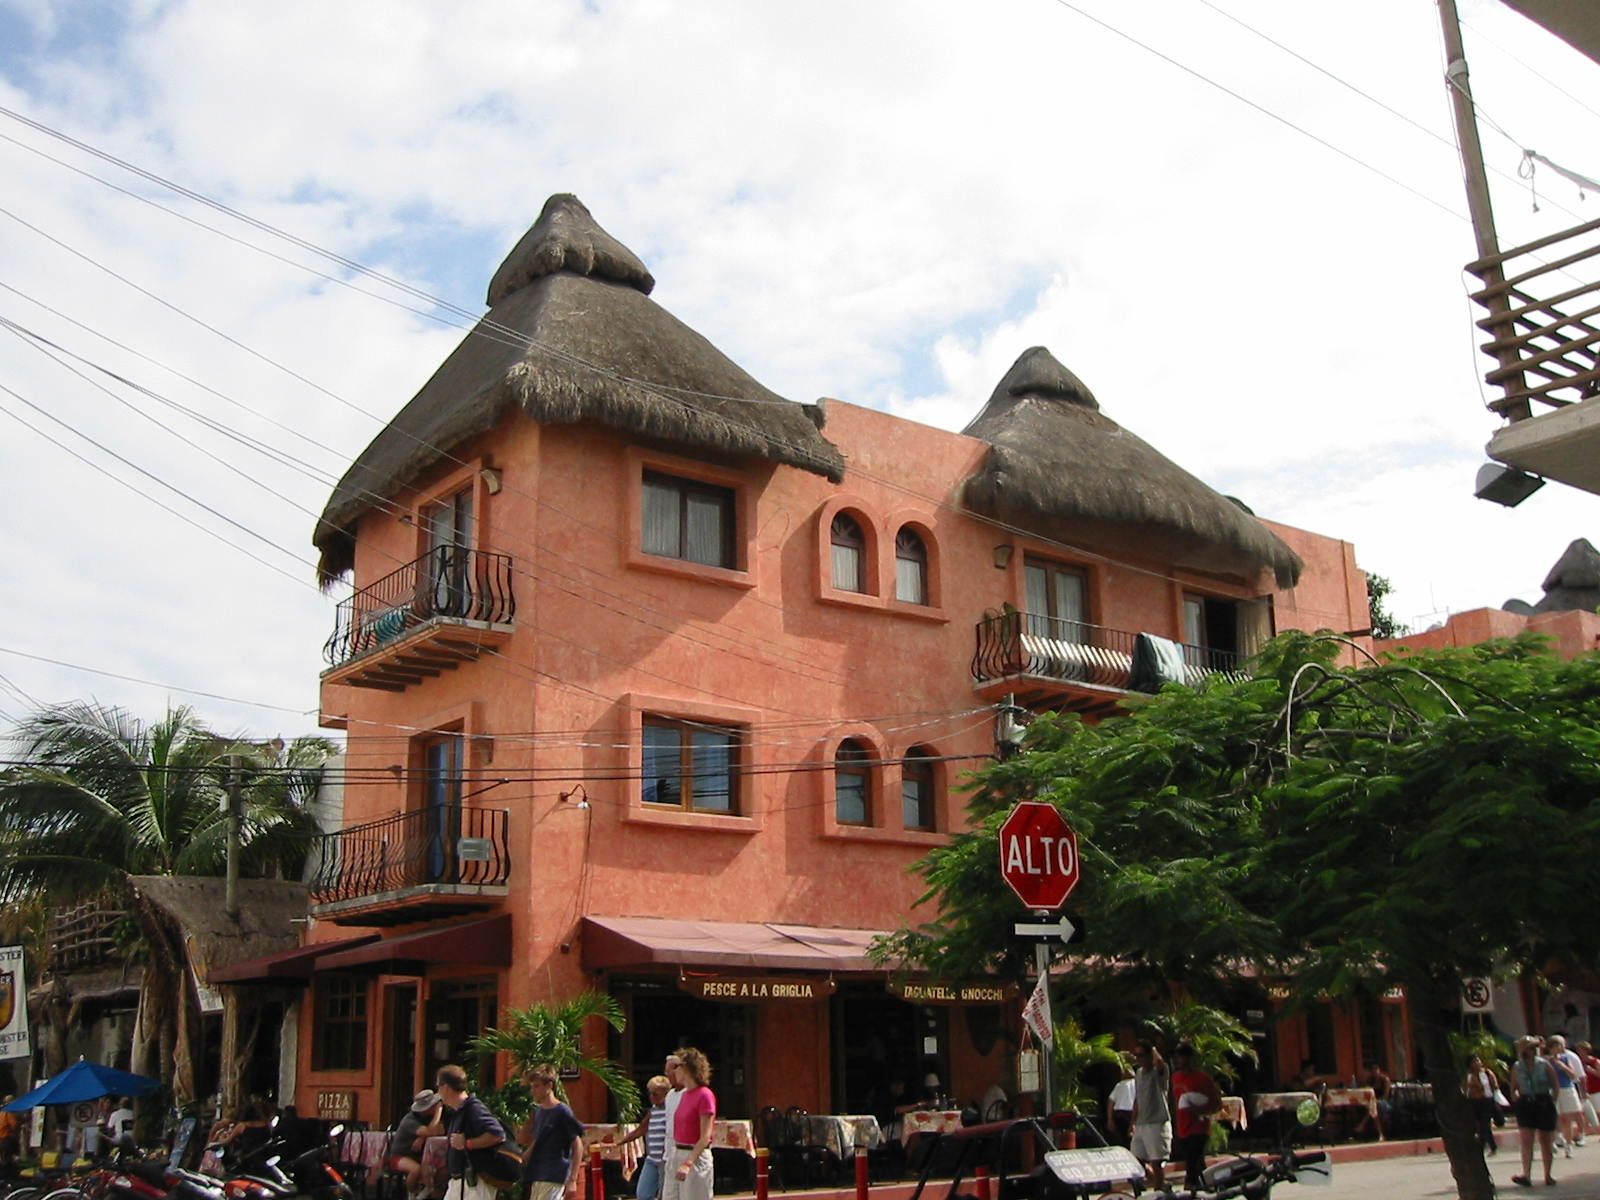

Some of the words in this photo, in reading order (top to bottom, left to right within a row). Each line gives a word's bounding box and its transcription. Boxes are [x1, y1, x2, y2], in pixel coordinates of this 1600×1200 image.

[1007, 834, 1074, 876] ALTO
[703, 983, 737, 996] PESCE
[740, 984, 749, 996] A
[752, 984, 768, 997] LA
[772, 984, 813, 998] GRIGLIA
[961, 988, 1003, 1001] GNOCCHI
[319, 1094, 350, 1109] PIZZA
